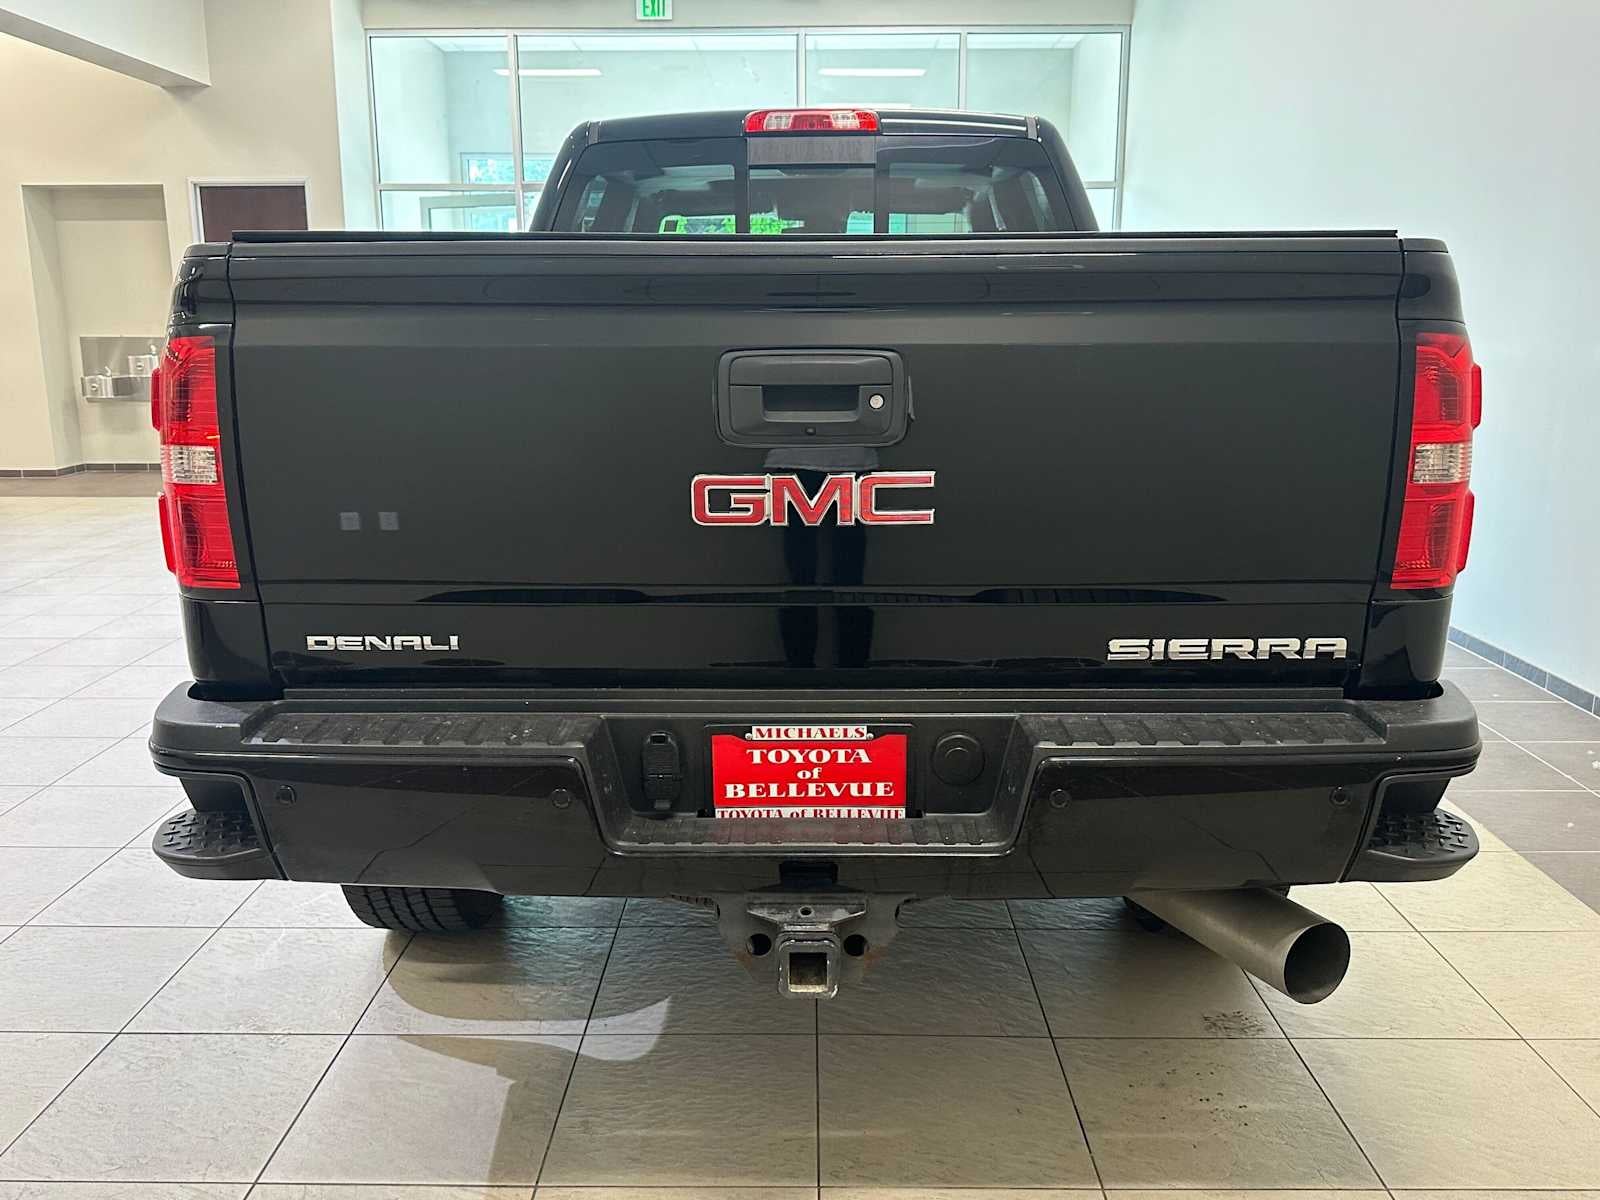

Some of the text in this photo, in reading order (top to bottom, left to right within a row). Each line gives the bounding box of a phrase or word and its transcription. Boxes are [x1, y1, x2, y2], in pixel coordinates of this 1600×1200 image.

[642, 0, 667, 17] EXIT
[691, 470, 936, 526] GMC
[306, 635, 459, 651] DENALI
[1107, 637, 1348, 661] SIERRA
[754, 727, 866, 739] MICHAELS
[746, 748, 872, 764] TOYOTA
[796, 767, 822, 779] of
[724, 782, 895, 799] BELLEVUE
[717, 809, 785, 818] TOYOTA
[789, 809, 810, 818] of
